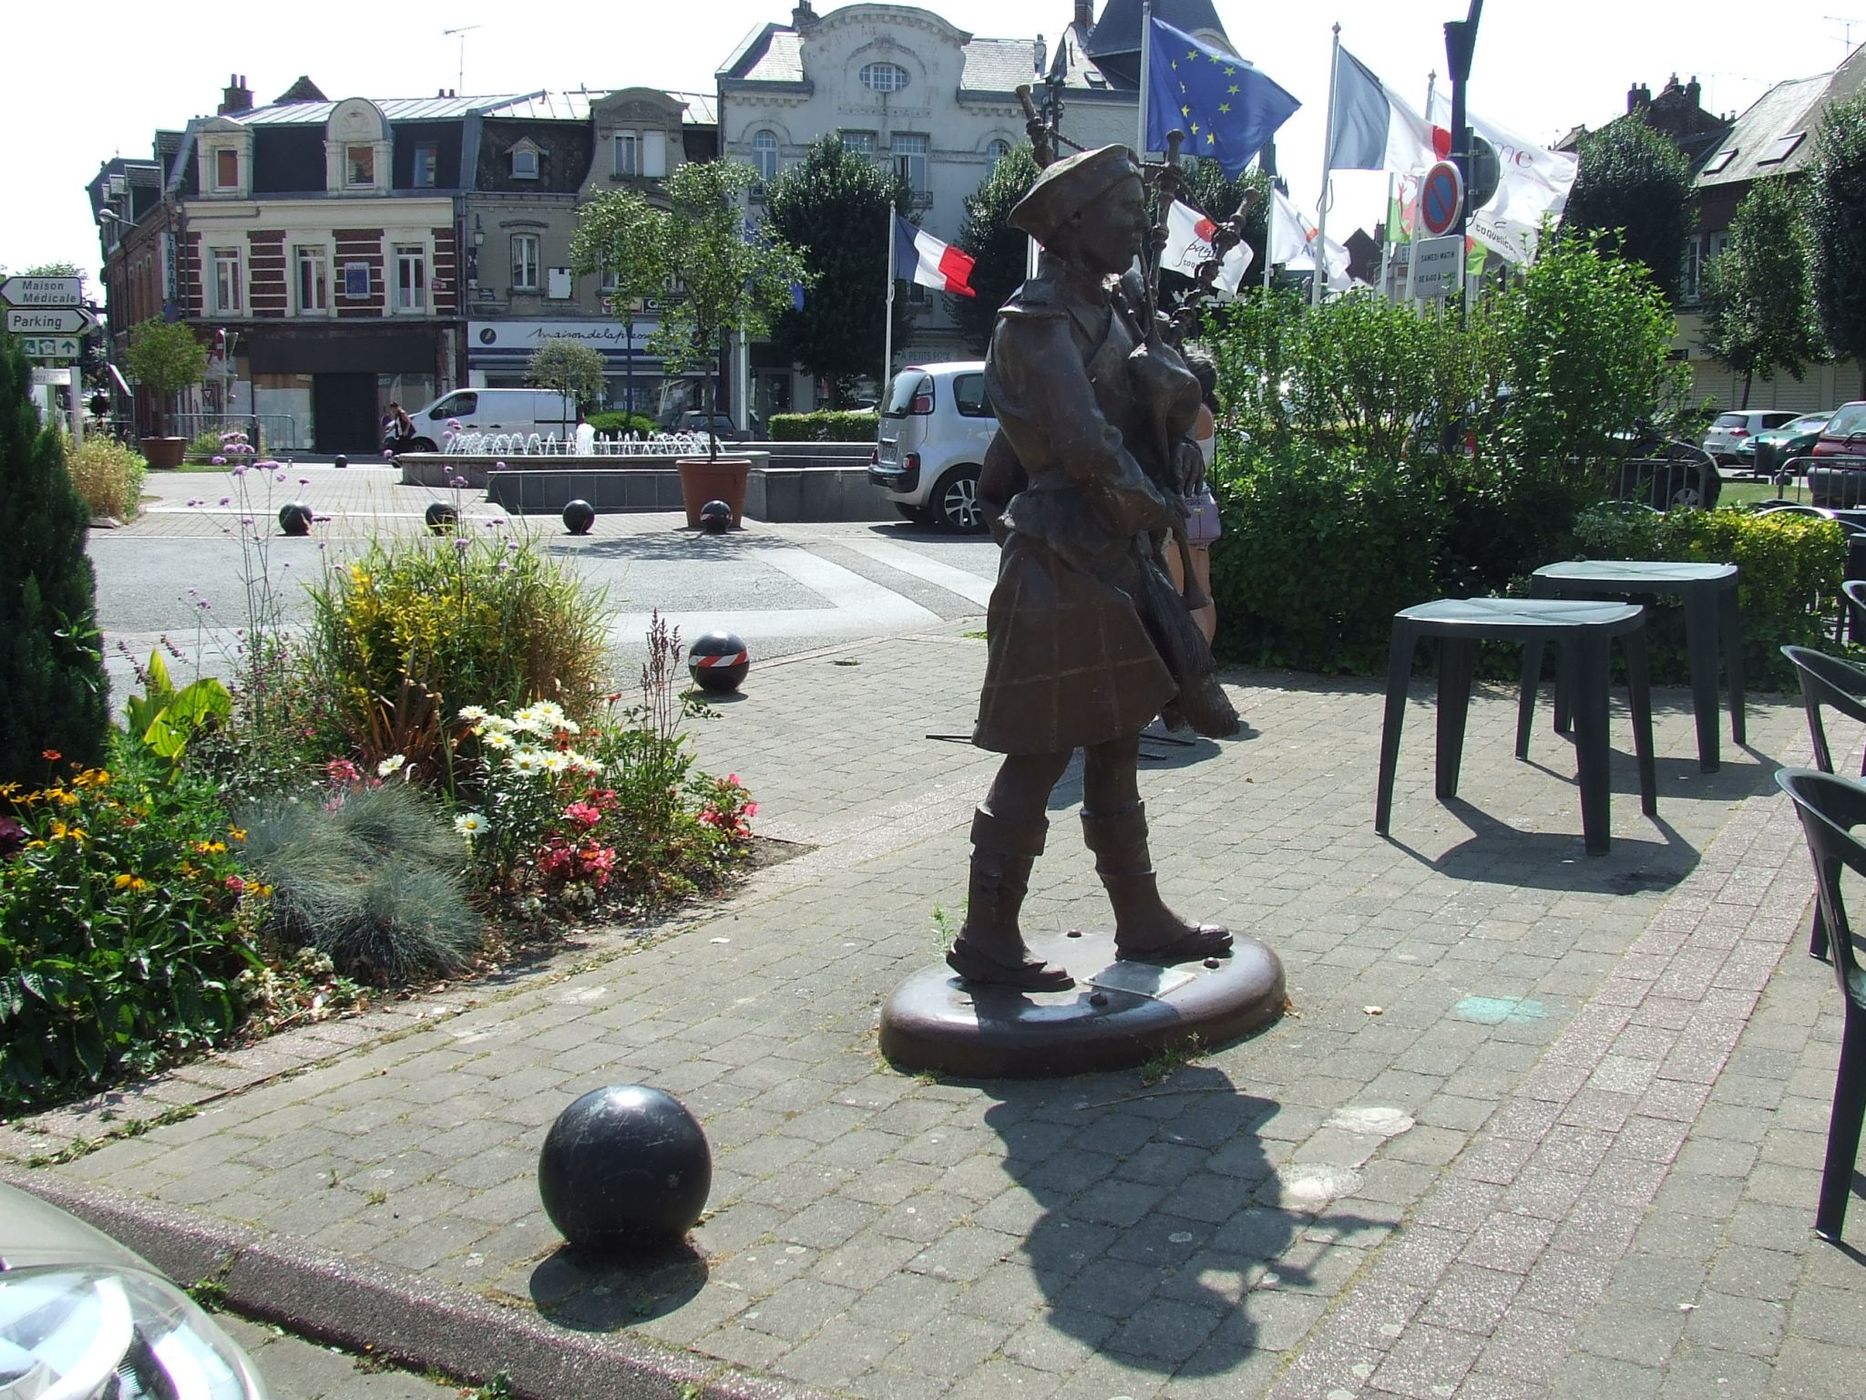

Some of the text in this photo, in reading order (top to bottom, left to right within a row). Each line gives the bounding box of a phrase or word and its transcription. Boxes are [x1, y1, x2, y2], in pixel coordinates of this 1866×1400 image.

[22, 281, 64, 291] Maison
[23, 291, 77, 304] Médicale
[13, 315, 62, 330] Parking
